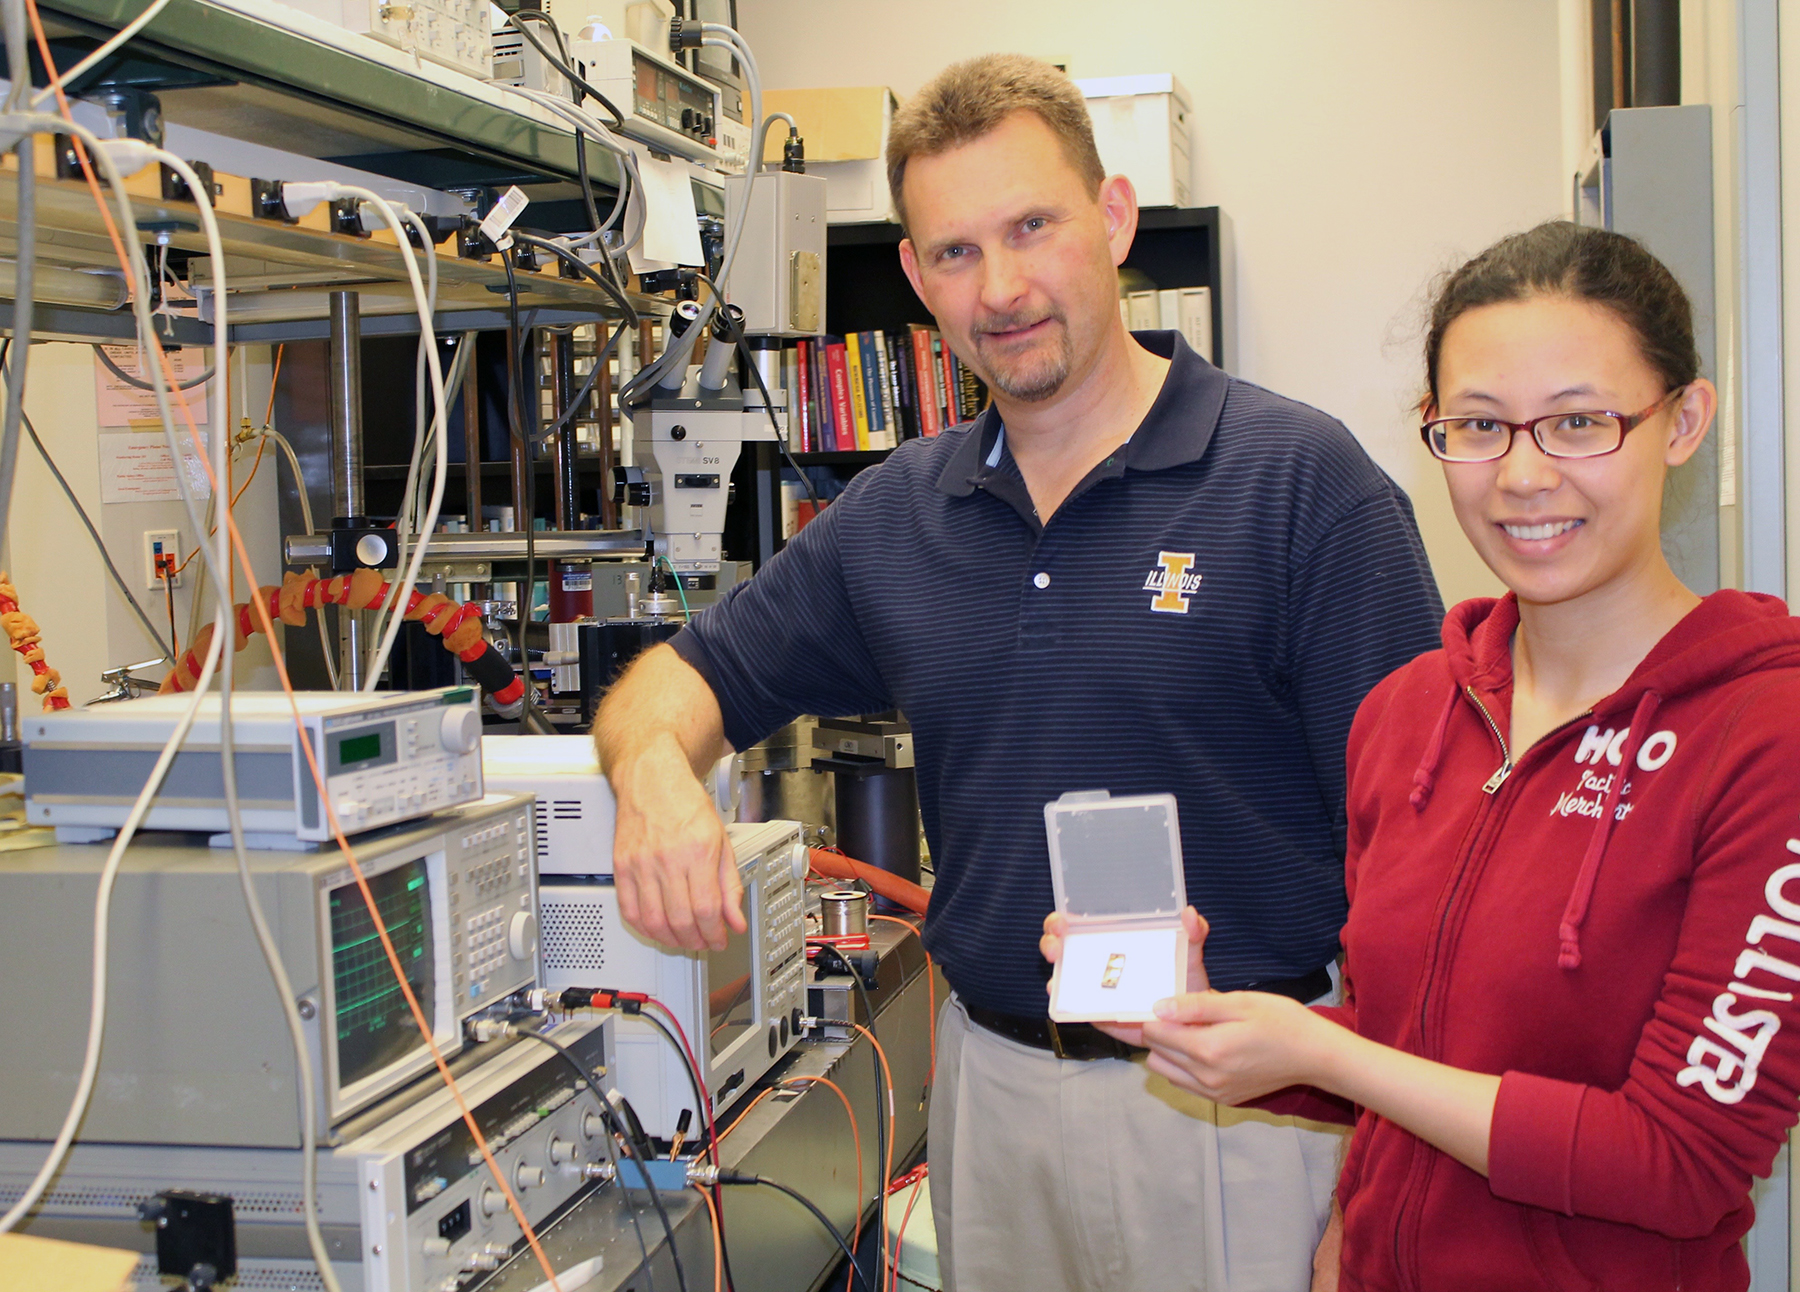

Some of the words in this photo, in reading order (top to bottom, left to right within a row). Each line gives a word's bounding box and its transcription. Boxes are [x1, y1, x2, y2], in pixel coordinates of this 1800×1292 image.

[834, 368, 846, 401] Complex
[838, 401, 849, 436] Variables
[702, 456, 720, 465] SV8
[1144, 570, 1202, 591] ILLINOIS
[1550, 791, 1635, 821] Merchnt
[1676, 813, 1800, 1105] OLLISTER
